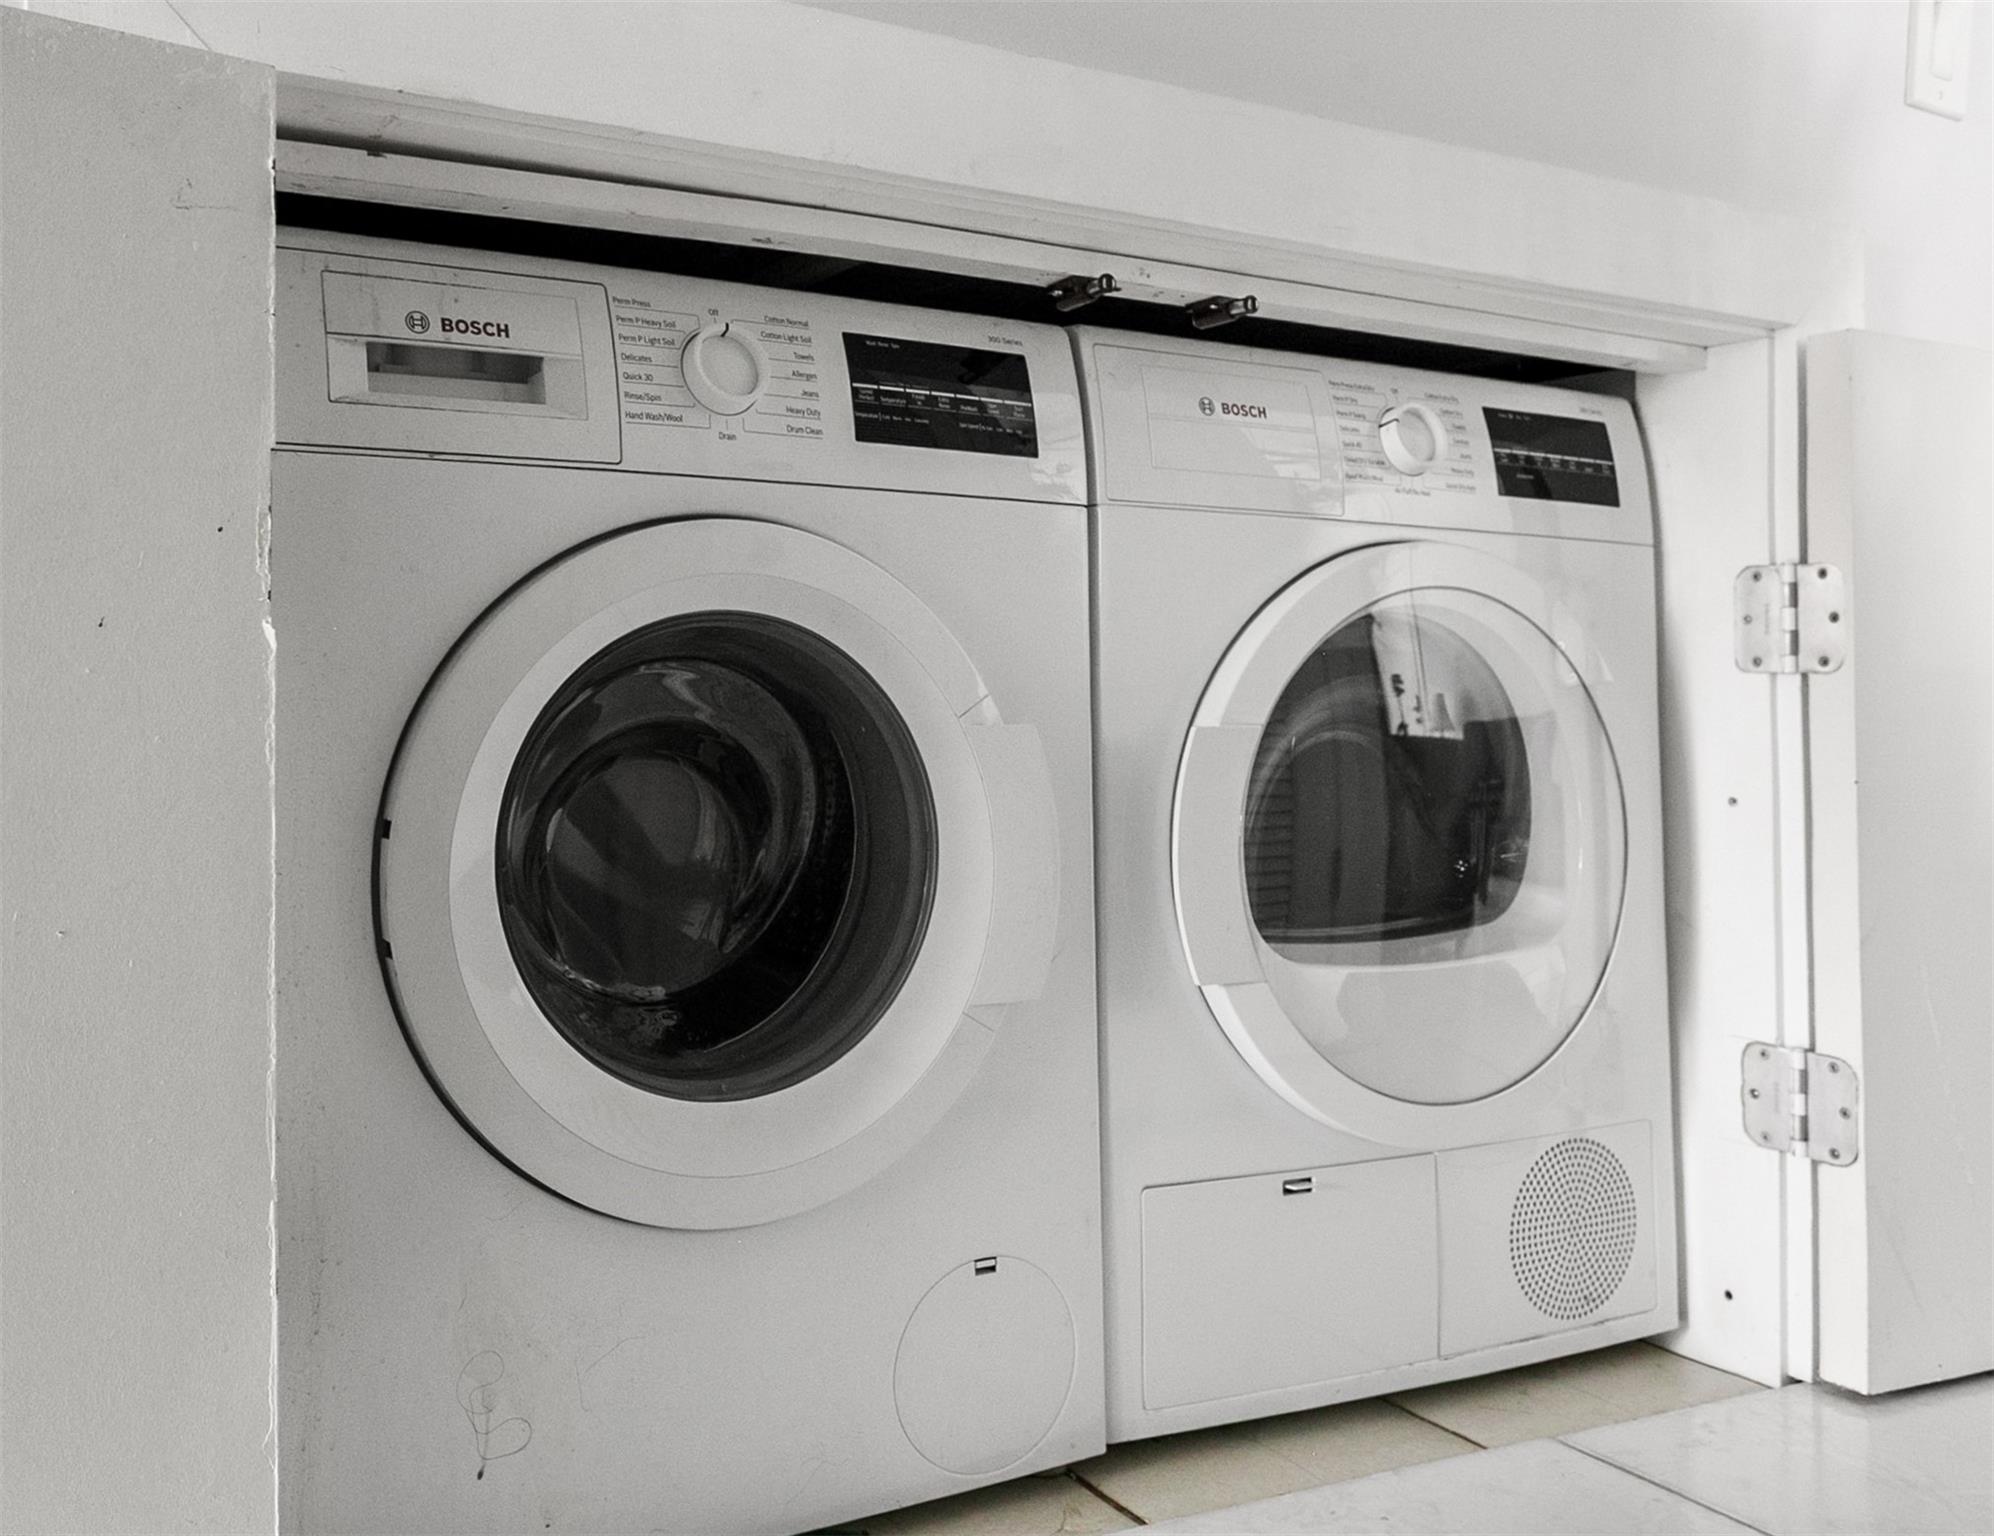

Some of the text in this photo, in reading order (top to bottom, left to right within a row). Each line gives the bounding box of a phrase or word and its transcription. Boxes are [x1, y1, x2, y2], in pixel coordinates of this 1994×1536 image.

[612, 296, 652, 308] Perm Press
[708, 308, 719, 317] Off
[616, 315, 634, 324] Perm
[641, 319, 662, 329] Heavy
[663, 320, 677, 329] Soil
[764, 315, 809, 327] Cotton Normal
[440, 317, 510, 339] BOSCH
[618, 333, 637, 342] Perm
[643, 335, 662, 346] Light
[662, 338, 676, 346] Soil
[760, 330, 812, 343] Cotton Light Soil
[621, 352, 653, 362] Delicates
[793, 351, 815, 361] Towels
[623, 371, 654, 382] Quick 30
[624, 391, 662, 402] Rinse/Spin
[625, 411, 683, 422] Hand Wash/Wool
[786, 405, 821, 419] Heavy Duty
[1221, 402, 1268, 420] BOSCH
[718, 431, 737, 441] Drain
[786, 424, 824, 436] Drum Clean
